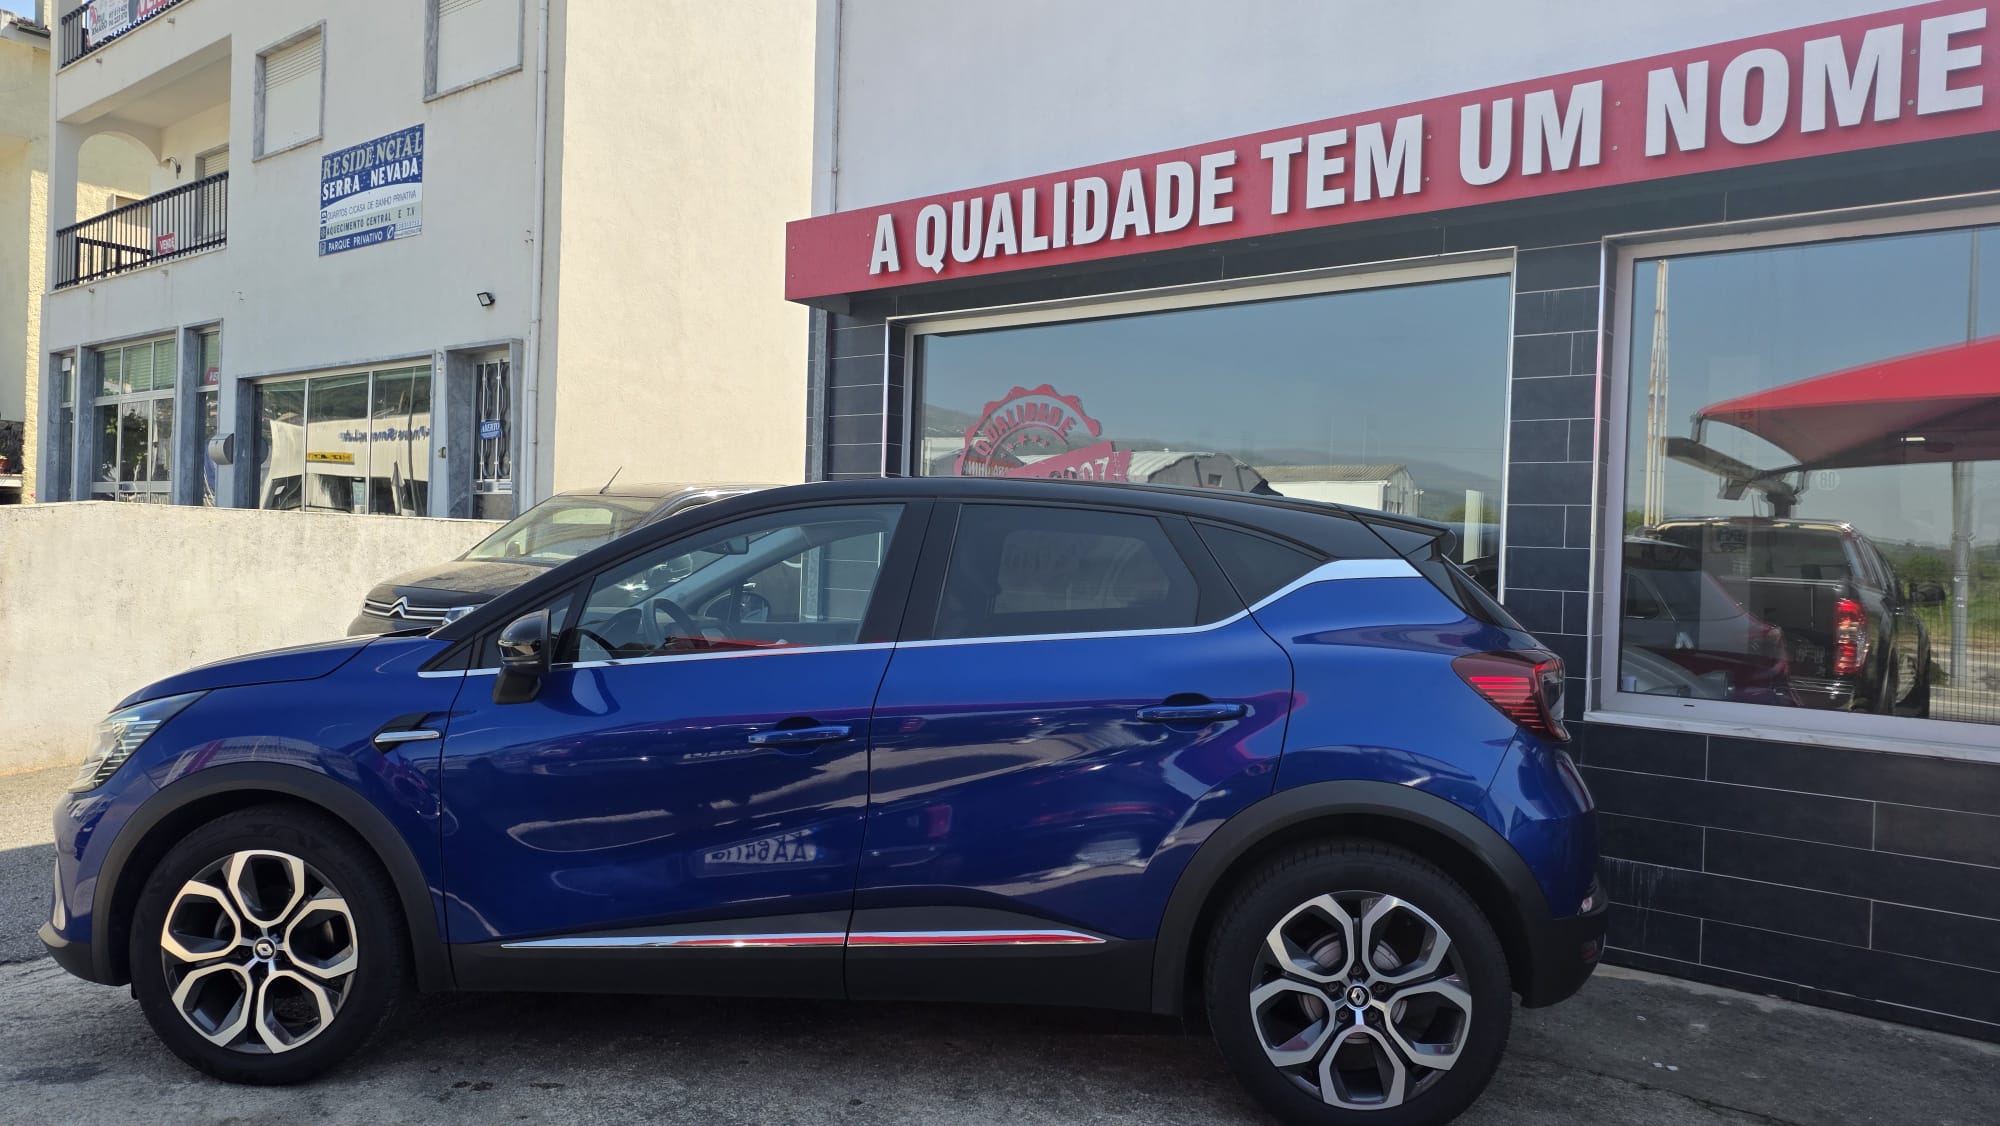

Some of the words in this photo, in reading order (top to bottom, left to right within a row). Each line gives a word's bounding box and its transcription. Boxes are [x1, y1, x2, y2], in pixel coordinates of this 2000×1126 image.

[323, 131, 423, 180] RESIDENCIAL
[870, 214, 900, 275] A
[915, 150, 1237, 275] QUALIDADE
[1261, 113, 1423, 215] TEM
[1459, 79, 1603, 187] UM
[1645, 7, 1987, 157] NOME
[323, 174, 360, 201] SERRA
[370, 157, 418, 188] NEVADA
[393, 189, 417, 203] PRIVATIVA
[327, 220, 364, 236] AQUECIMENTO
[366, 212, 392, 226] CENTRAL
[398, 209, 402, 219] E
[328, 238, 351, 252] PARQUE
[353, 231, 383, 247] PRIVATIVO
[975, 402, 1076, 456] QUALIDADE
[1049, 456, 1109, 481] 07
